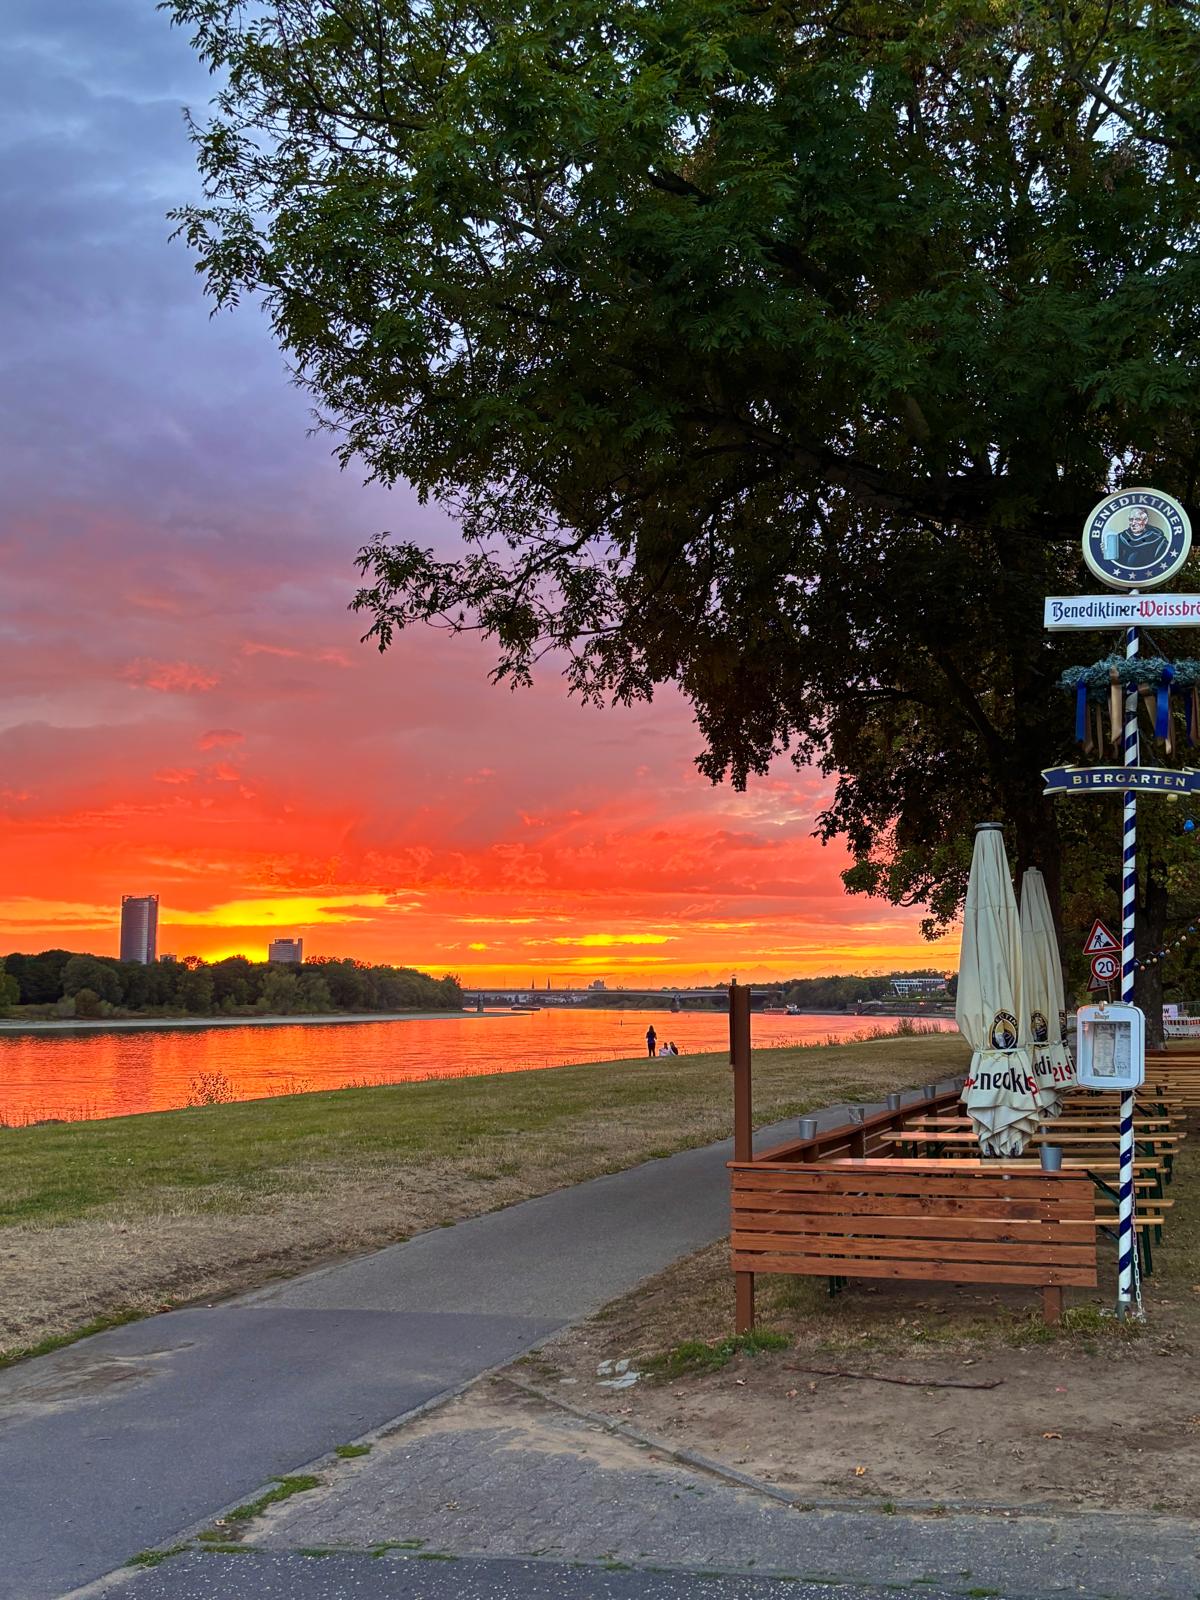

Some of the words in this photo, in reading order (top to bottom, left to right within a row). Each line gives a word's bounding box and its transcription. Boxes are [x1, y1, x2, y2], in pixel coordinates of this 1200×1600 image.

[1091, 495, 1183, 539] BENEDIKTINER
[1051, 601, 1137, 622] Benediktiner
[1072, 773, 1186, 787] BIERGARTEN
[1098, 961, 1114, 973] 20
